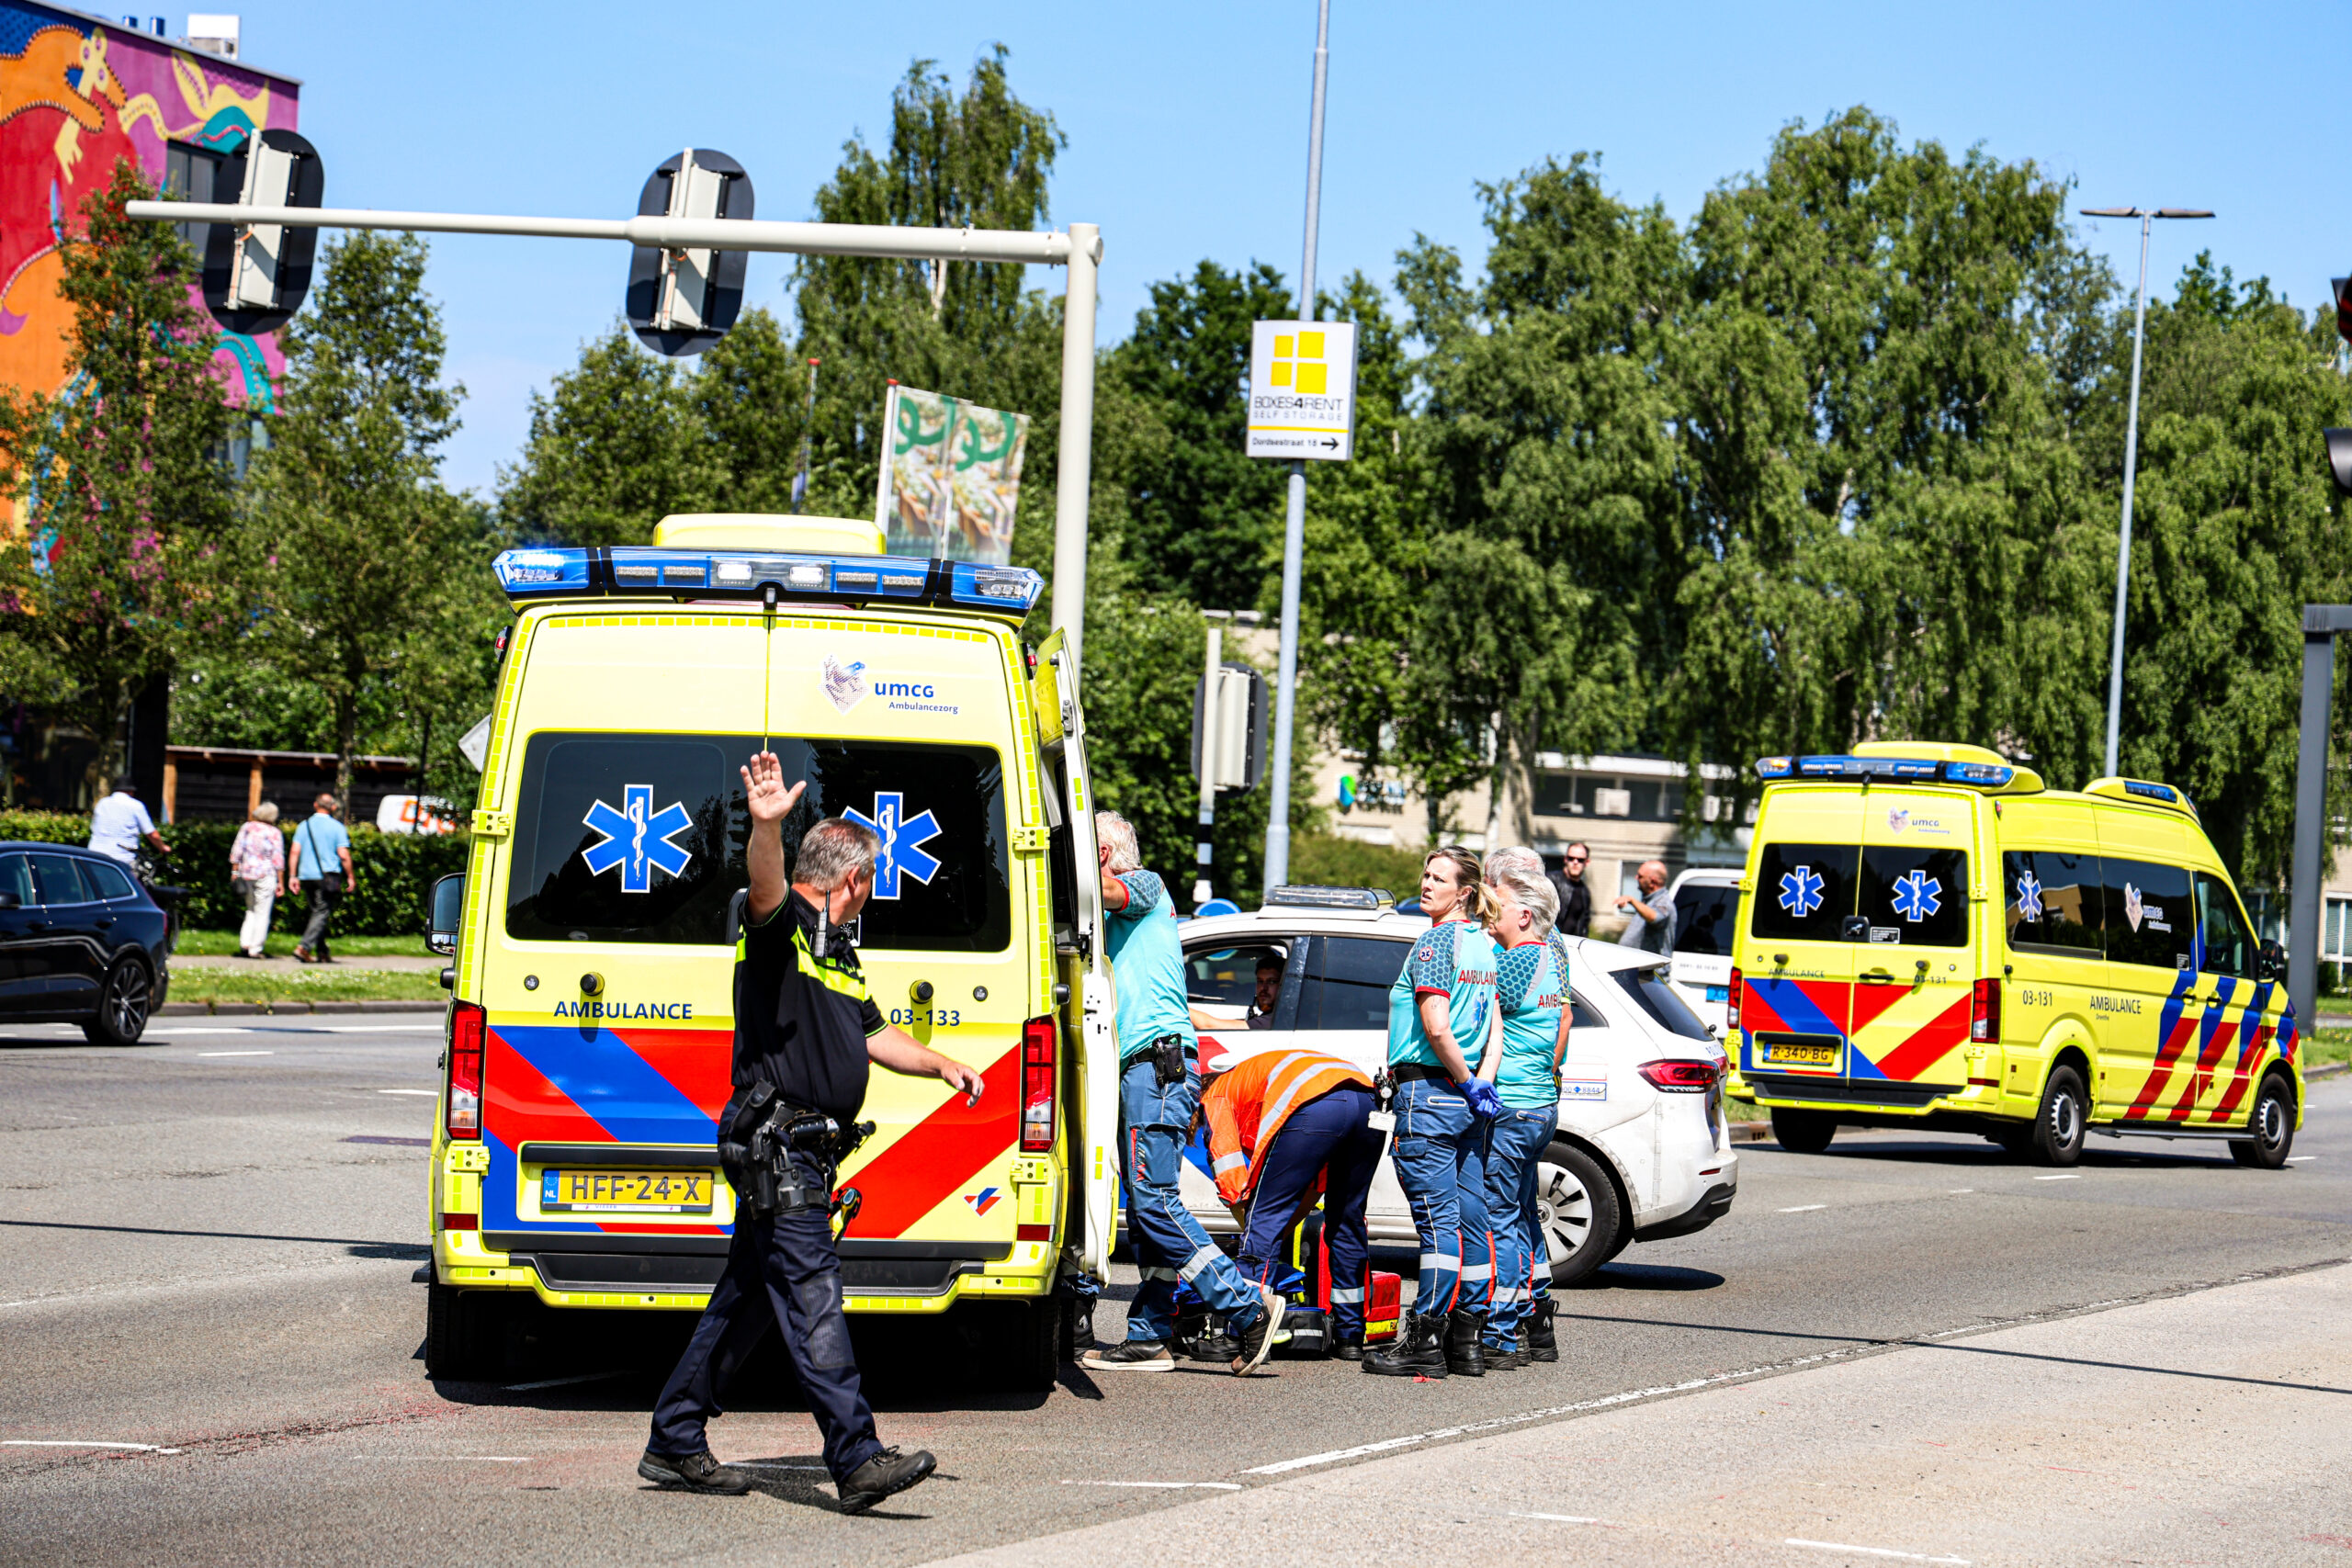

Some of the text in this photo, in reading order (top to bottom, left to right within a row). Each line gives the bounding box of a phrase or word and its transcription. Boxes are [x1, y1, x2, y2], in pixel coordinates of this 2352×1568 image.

[1254, 396, 1344, 411] BOXES4RENT
[1283, 411, 1343, 422] STORAGE
[888, 701, 958, 715] Ambulancezorg
[1768, 968, 1826, 977] AMBULANCE
[1914, 976, 1947, 984] 03-131
[2022, 990, 2052, 1006] 03-131
[2089, 996, 2142, 1014] AMBULANCE
[553, 1001, 693, 1020] AMBULANCE
[889, 1009, 960, 1026] 03-133
[1772, 1046, 1829, 1060] R-340-BG
[545, 1189, 557, 1199] NL
[571, 1175, 700, 1201] HFF-24-X
